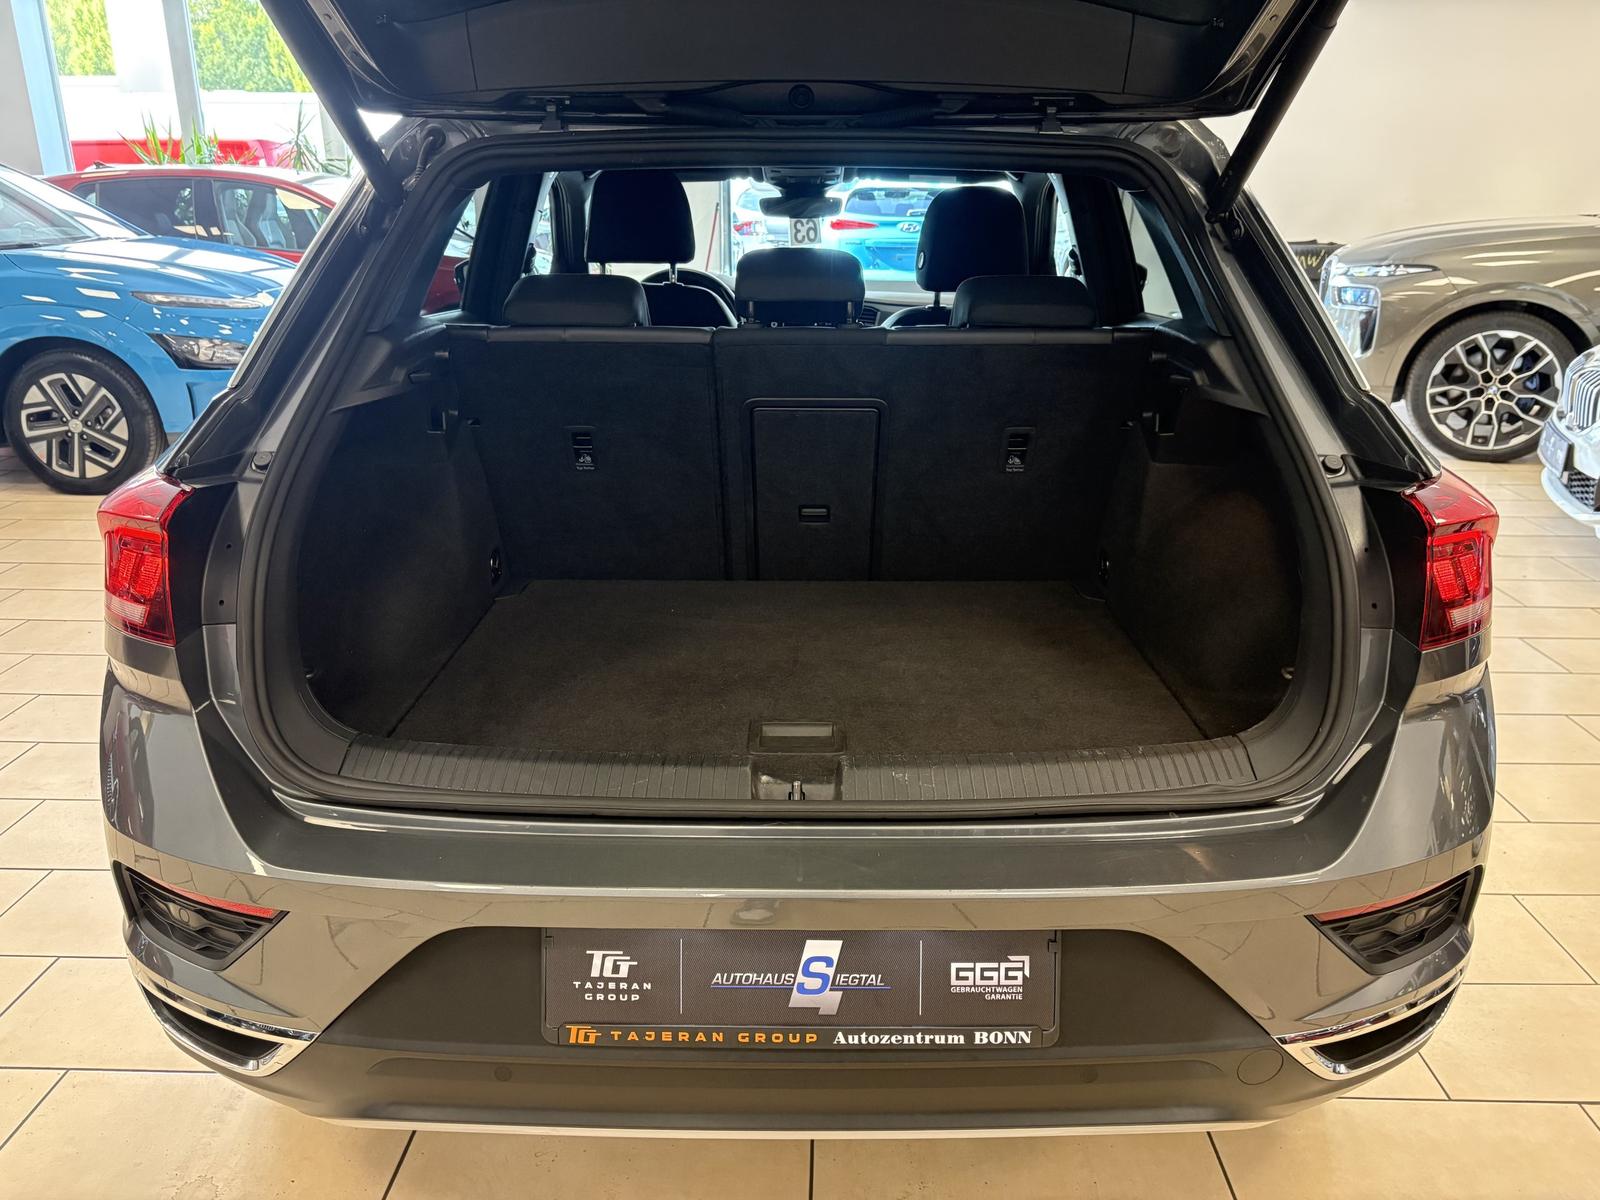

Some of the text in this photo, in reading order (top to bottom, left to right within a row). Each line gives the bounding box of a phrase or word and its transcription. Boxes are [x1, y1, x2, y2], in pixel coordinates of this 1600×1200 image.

[711, 955, 885, 996] AUTOHAUS SIEGTAL
[950, 962, 1023, 986] GGG
[572, 981, 652, 990] TAJERAN
[584, 993, 640, 1002] GROUP
[984, 993, 1023, 1001] GARANTIE
[610, 1031, 724, 1043] TAJERAN
[737, 1032, 817, 1044] GROUP
[833, 1031, 965, 1045] Autozentrum
[973, 1031, 1032, 1045] BONN
